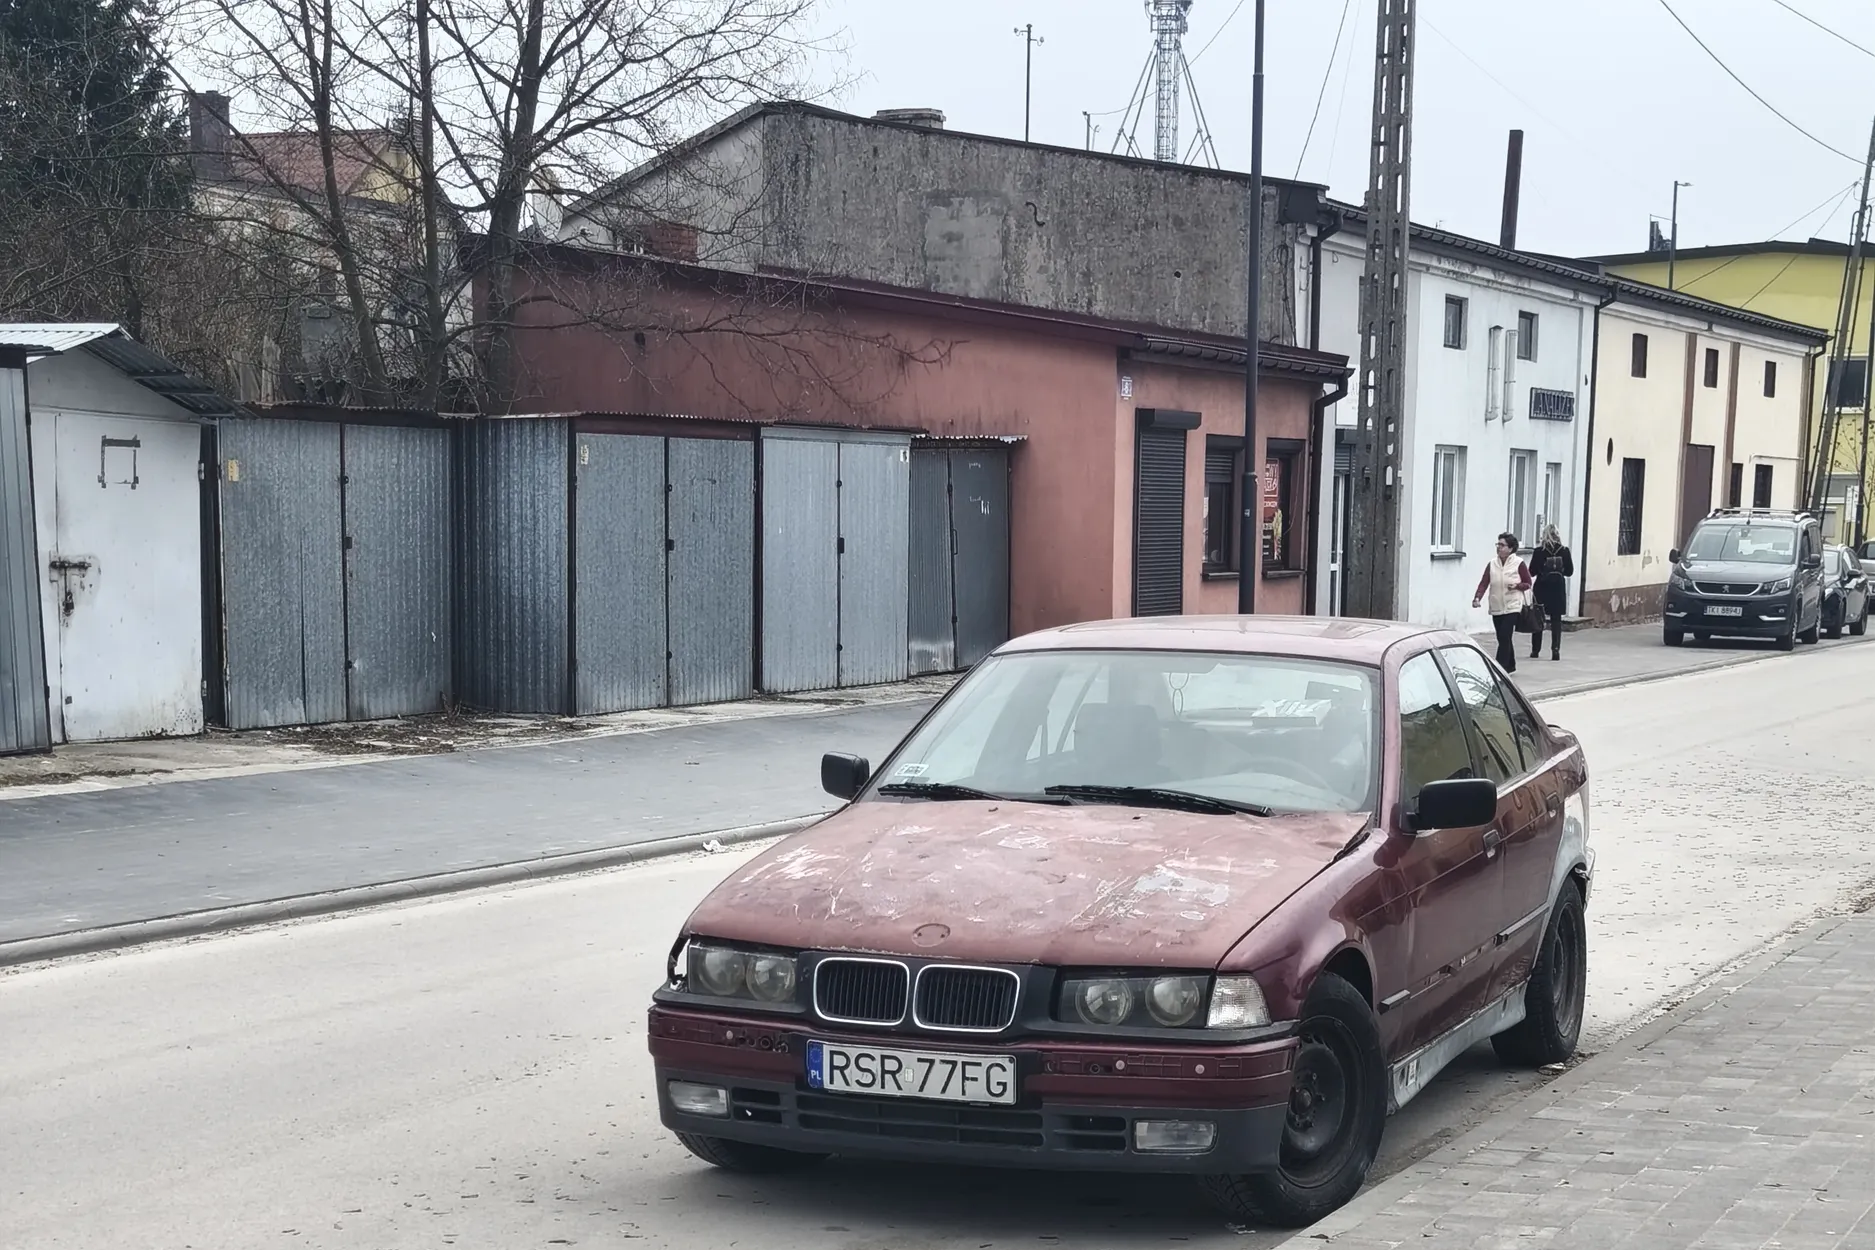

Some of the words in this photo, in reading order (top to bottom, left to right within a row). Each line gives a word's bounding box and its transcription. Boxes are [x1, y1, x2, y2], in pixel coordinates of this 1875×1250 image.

[811, 1070, 822, 1081] PL
[829, 1050, 903, 1090] RSR
[917, 1057, 1008, 1098] 77FG
